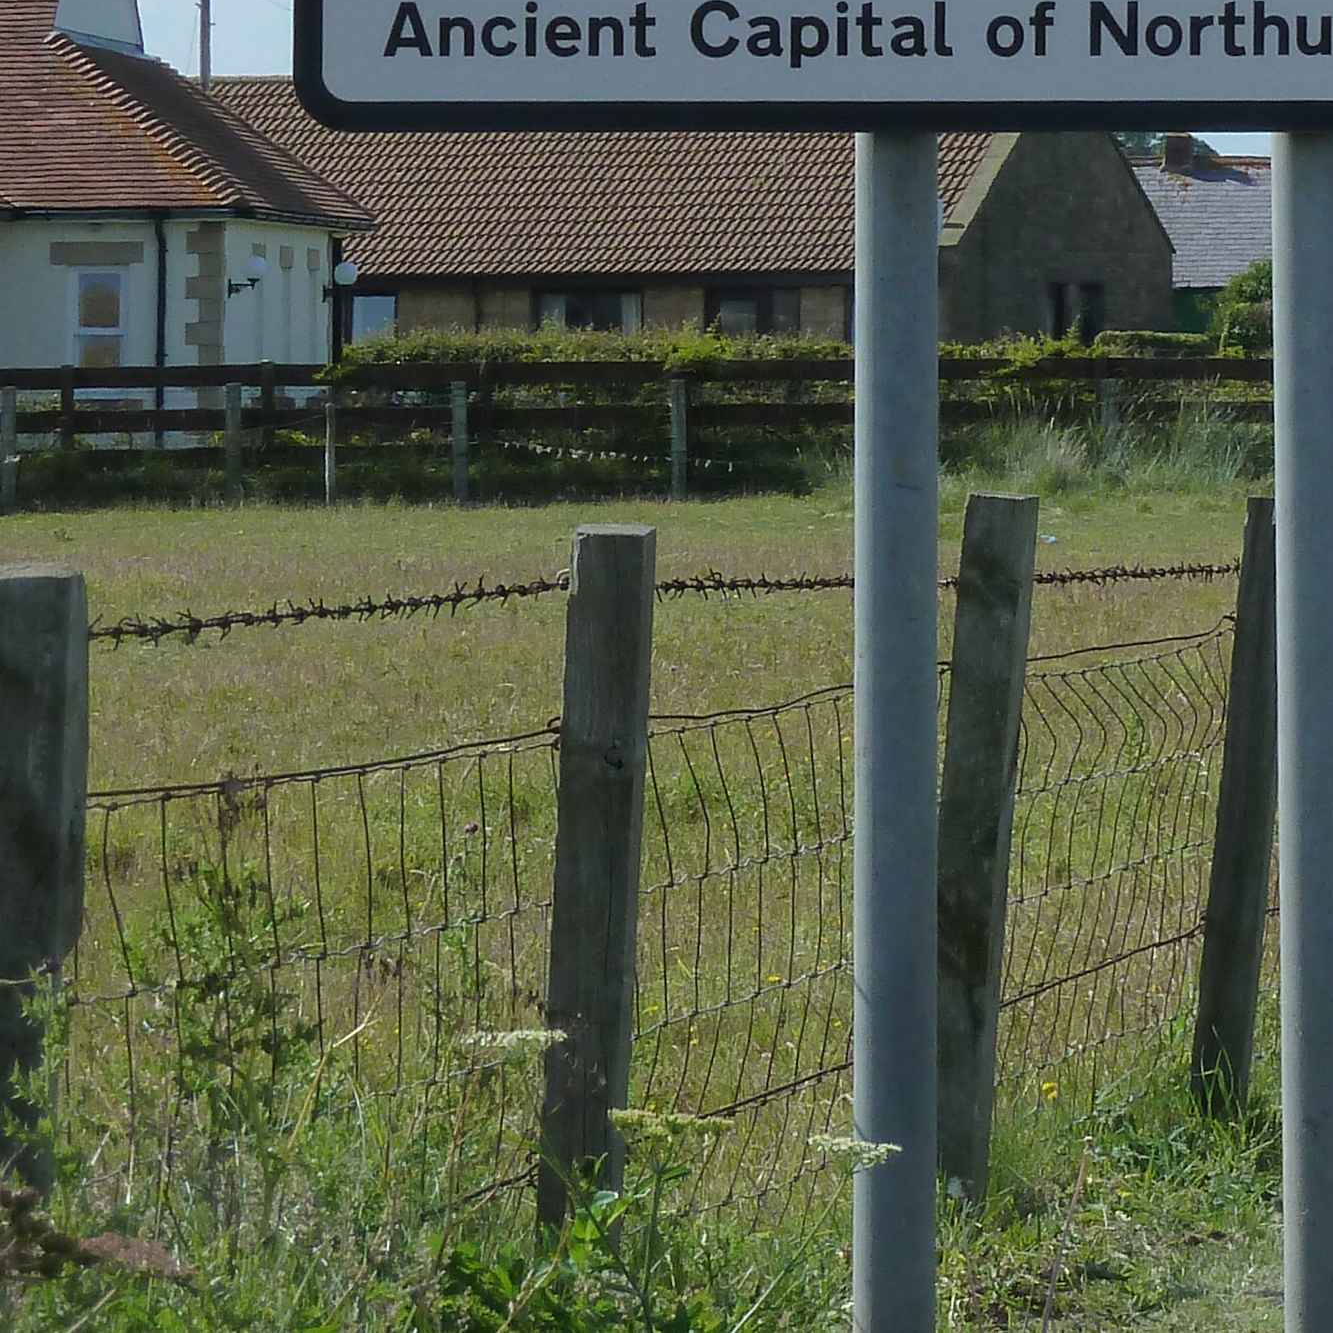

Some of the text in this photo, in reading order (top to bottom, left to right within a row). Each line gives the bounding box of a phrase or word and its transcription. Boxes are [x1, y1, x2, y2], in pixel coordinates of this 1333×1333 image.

[382, 0, 657, 59] Ancient
[689, 0, 954, 69] Capital
[985, 0, 1057, 58] of
